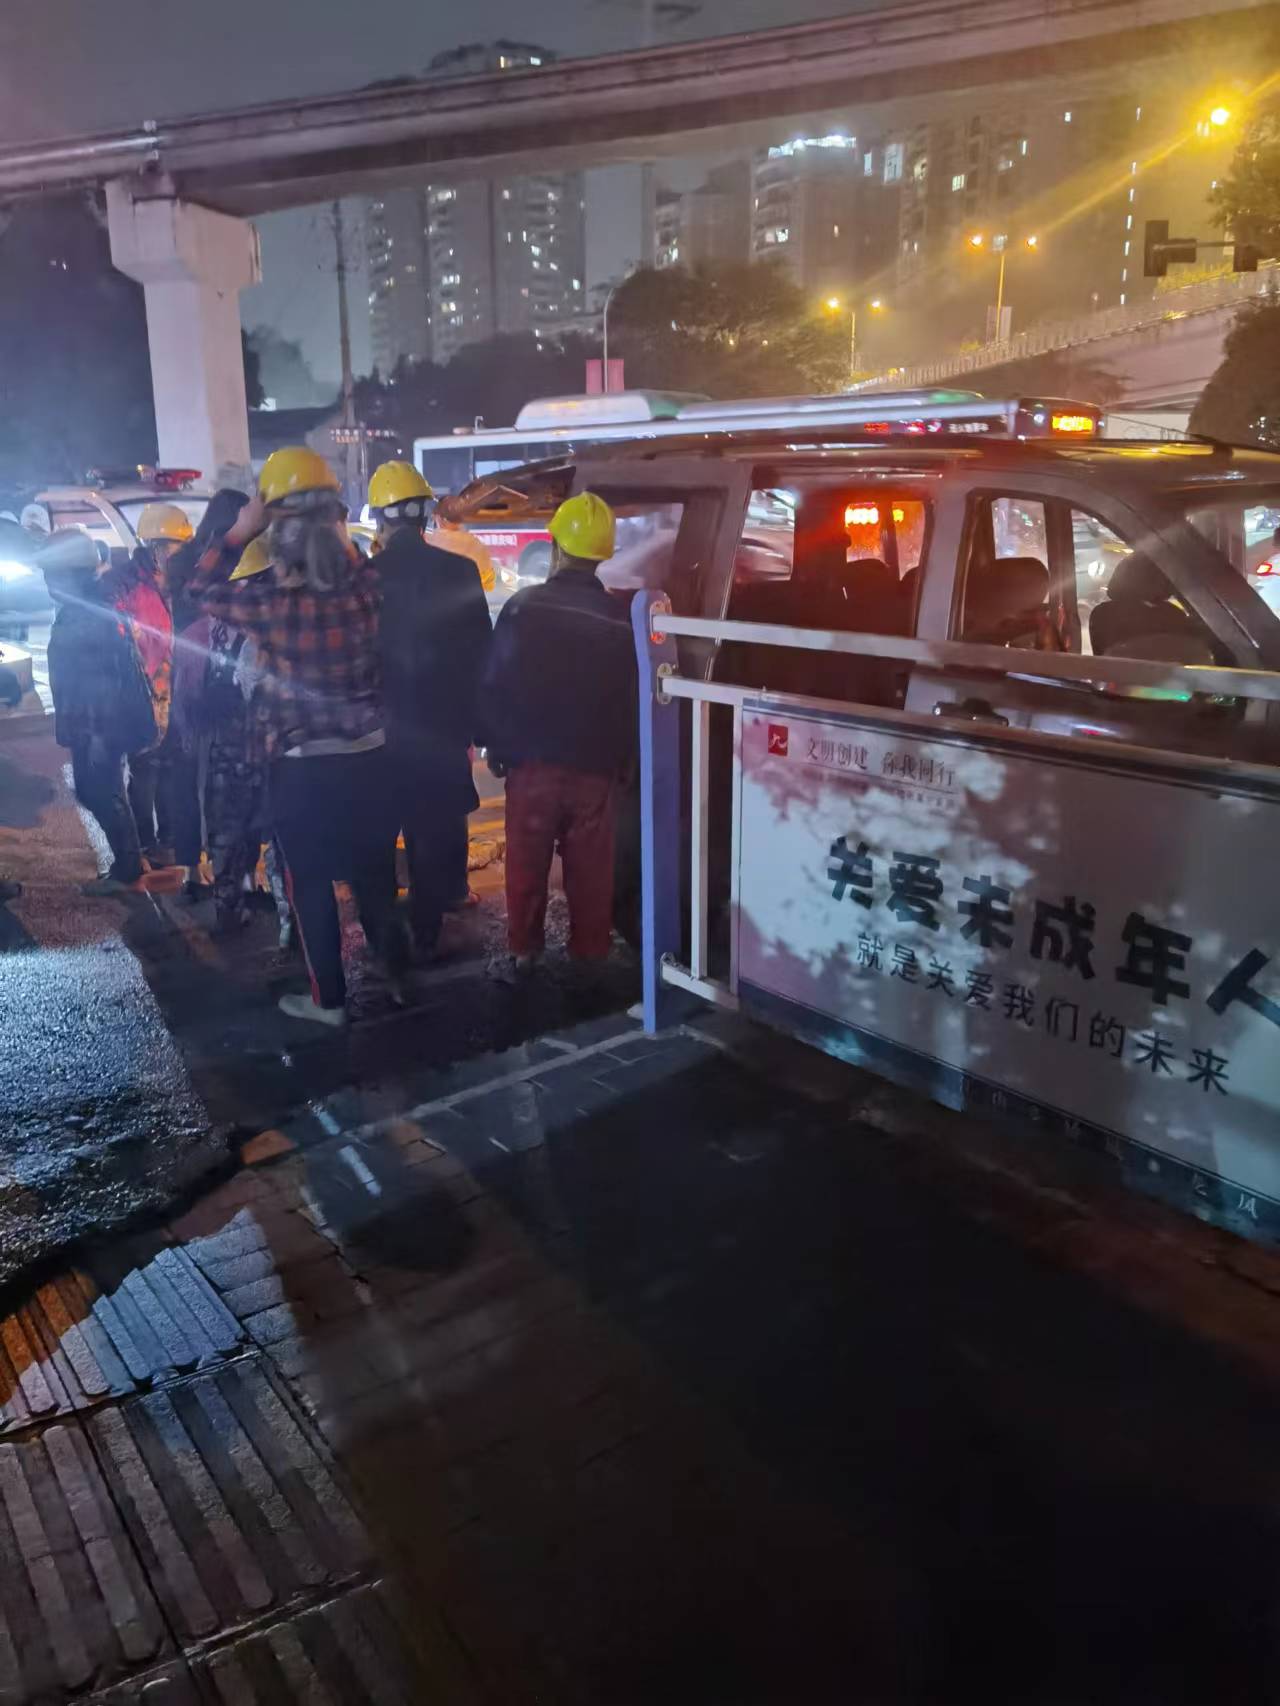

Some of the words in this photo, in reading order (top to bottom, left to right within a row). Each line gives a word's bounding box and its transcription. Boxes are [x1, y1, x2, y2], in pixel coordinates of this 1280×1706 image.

[807, 737, 869, 770] 文明创建
[881, 751, 954, 787] 你我同行
[827, 835, 1280, 1026] 关爱未成年人
[855, 931, 1229, 1096] 就是关爱我们的未来
